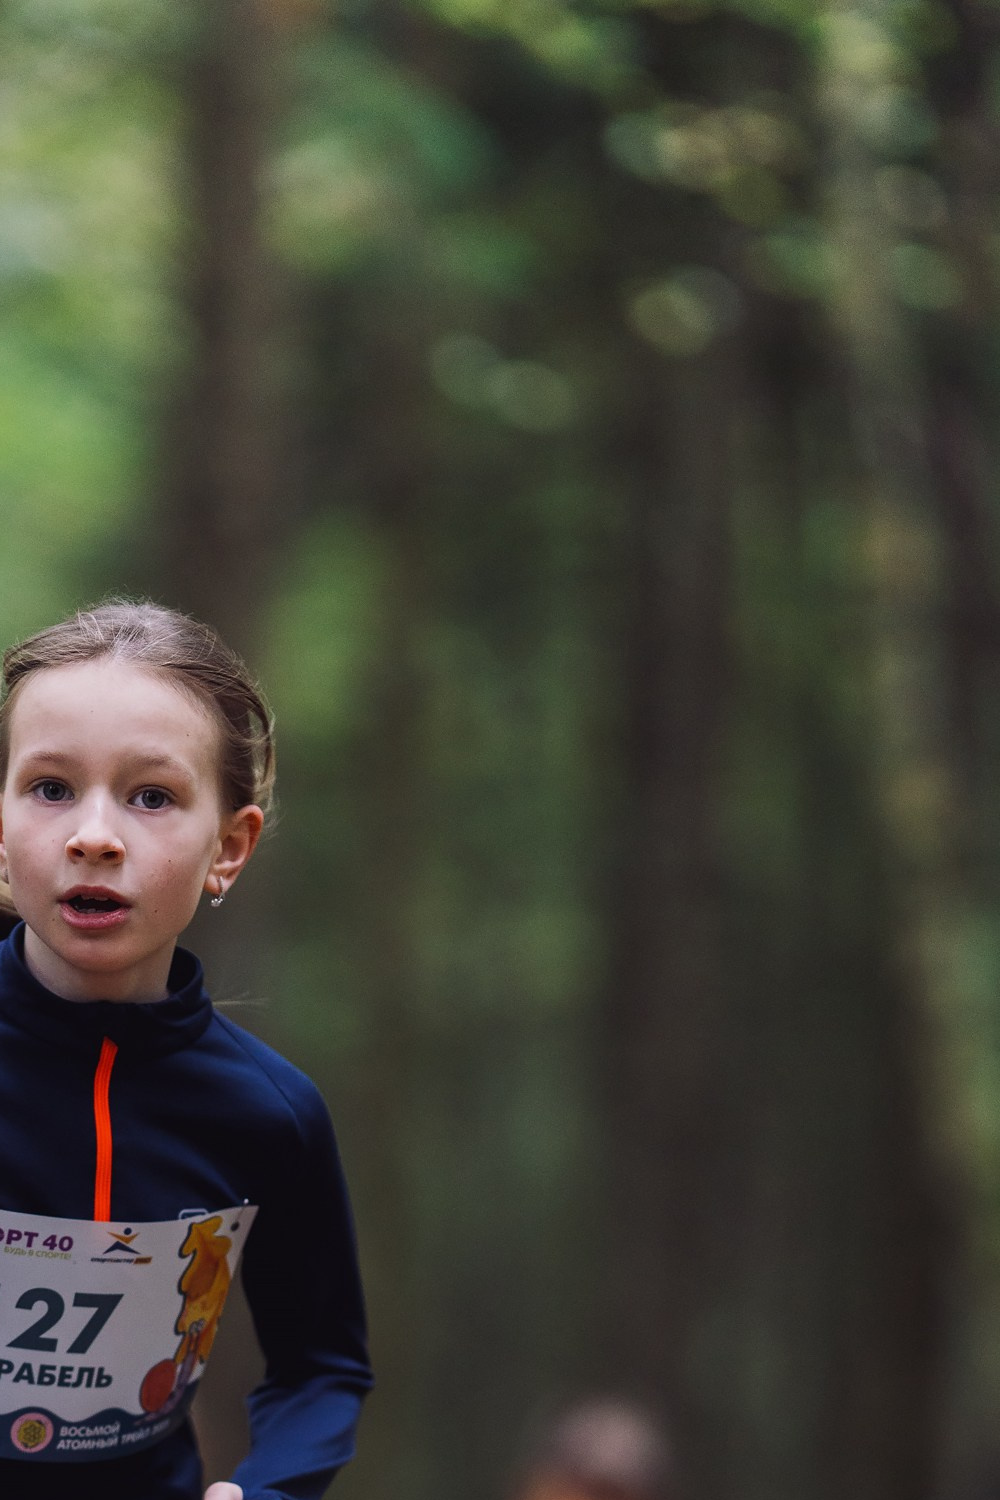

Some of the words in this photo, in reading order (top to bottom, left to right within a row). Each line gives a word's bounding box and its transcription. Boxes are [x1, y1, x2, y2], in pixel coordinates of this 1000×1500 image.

[42, 1234, 74, 1252] 40
[59, 1420, 121, 1437] ВОСЬМОЙ
[56, 1433, 119, 1450] АТОМНЫЙ
